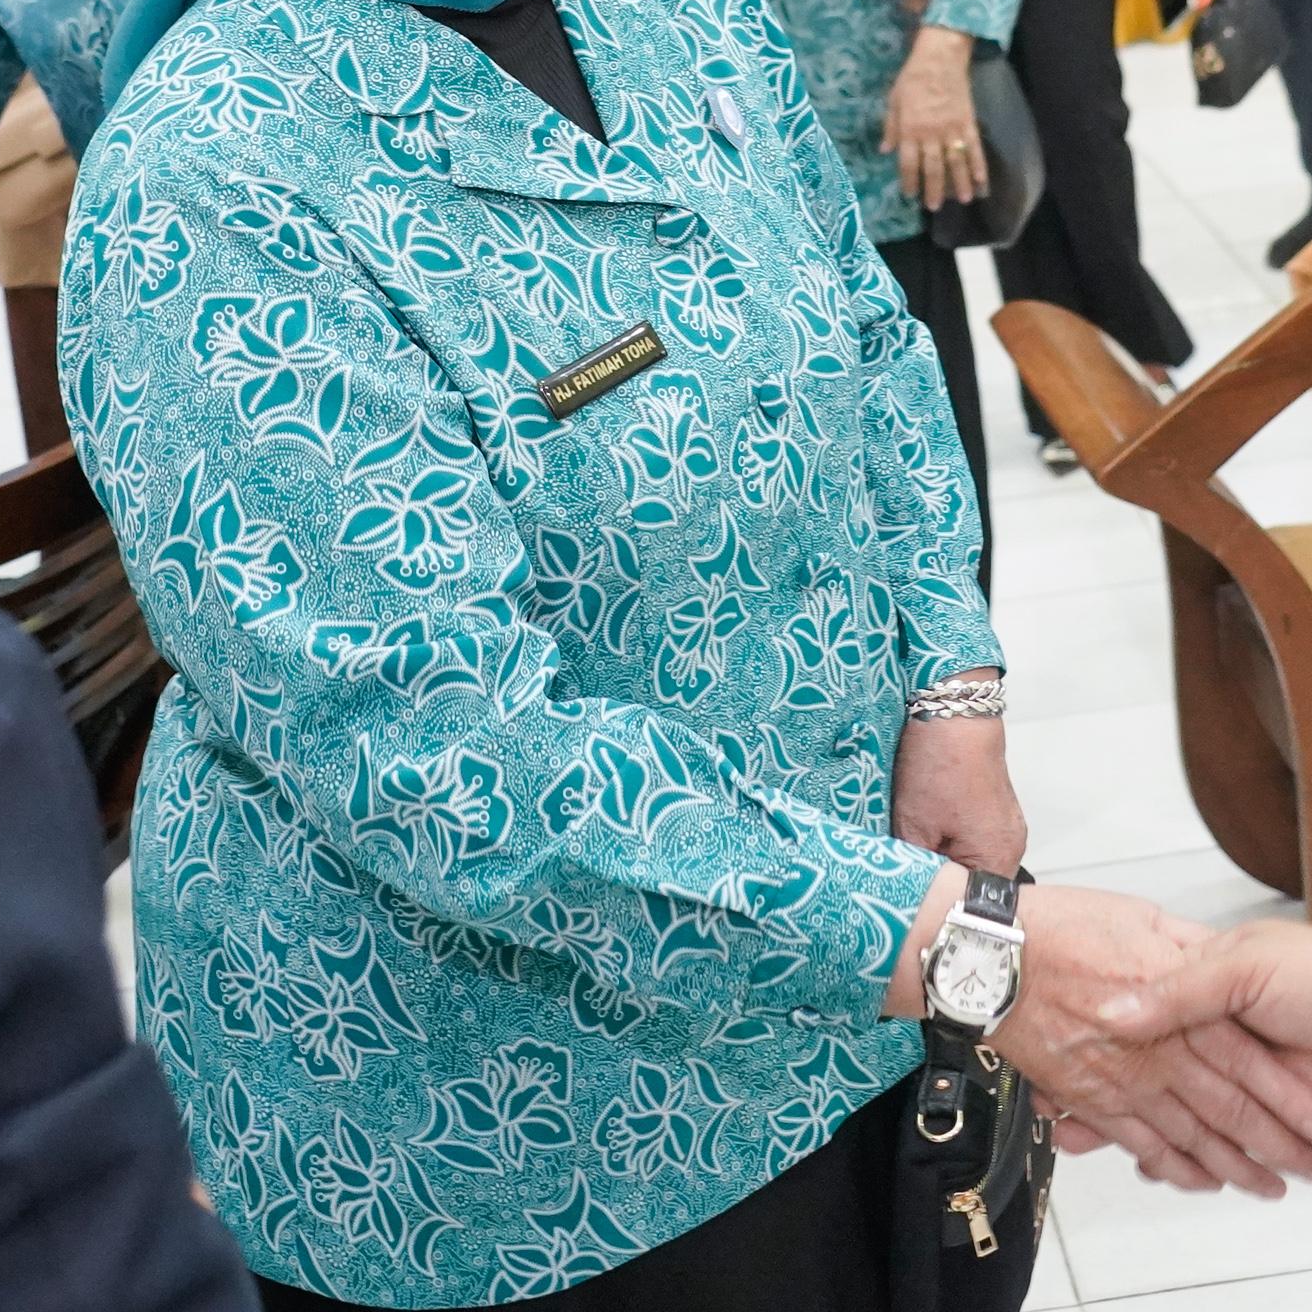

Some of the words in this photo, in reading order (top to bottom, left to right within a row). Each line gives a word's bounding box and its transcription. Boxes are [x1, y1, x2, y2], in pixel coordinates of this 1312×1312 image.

[553, 383, 575, 403] HJ.
[574, 355, 623, 391] FATIMAH
[623, 337, 657, 363] TOHA
